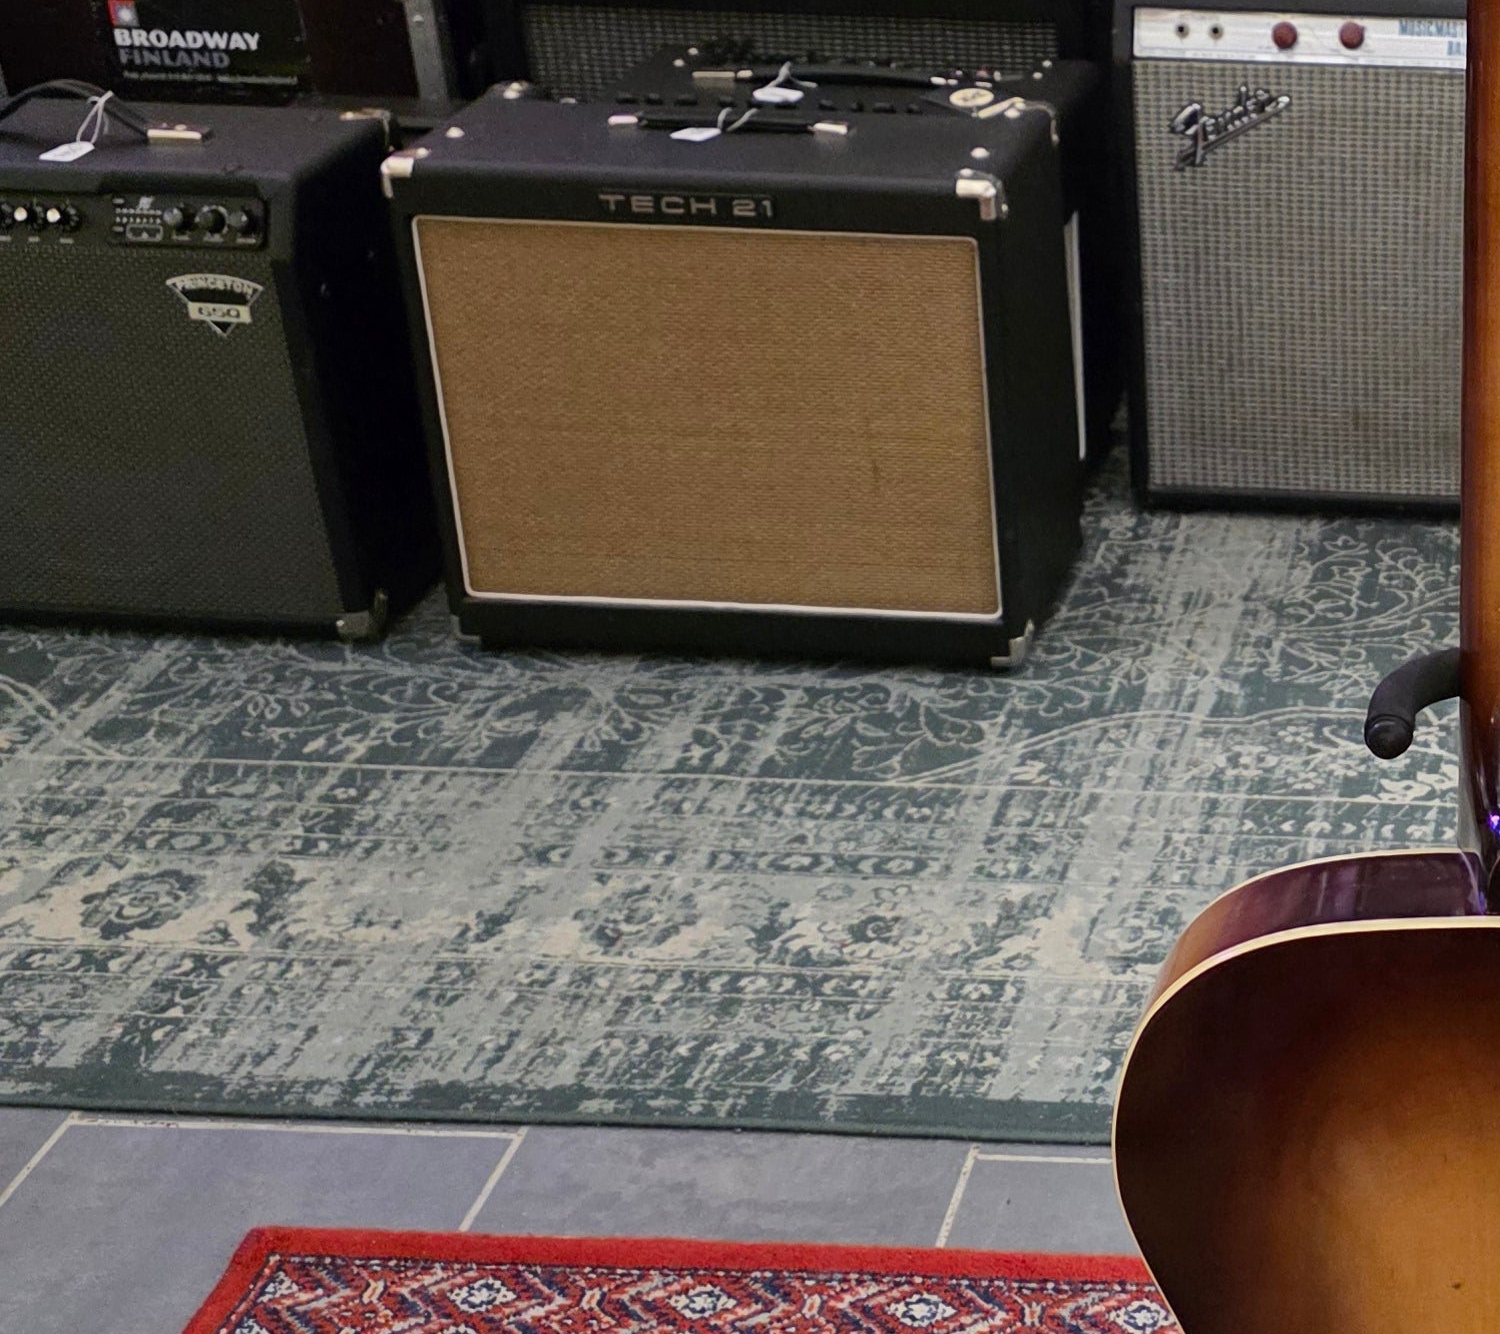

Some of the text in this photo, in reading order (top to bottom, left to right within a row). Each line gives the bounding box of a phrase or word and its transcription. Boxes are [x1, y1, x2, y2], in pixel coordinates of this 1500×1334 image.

[113, 28, 260, 51] BROADWAY
[119, 48, 231, 68] FINLAND
[598, 194, 774, 217] TECH 21
